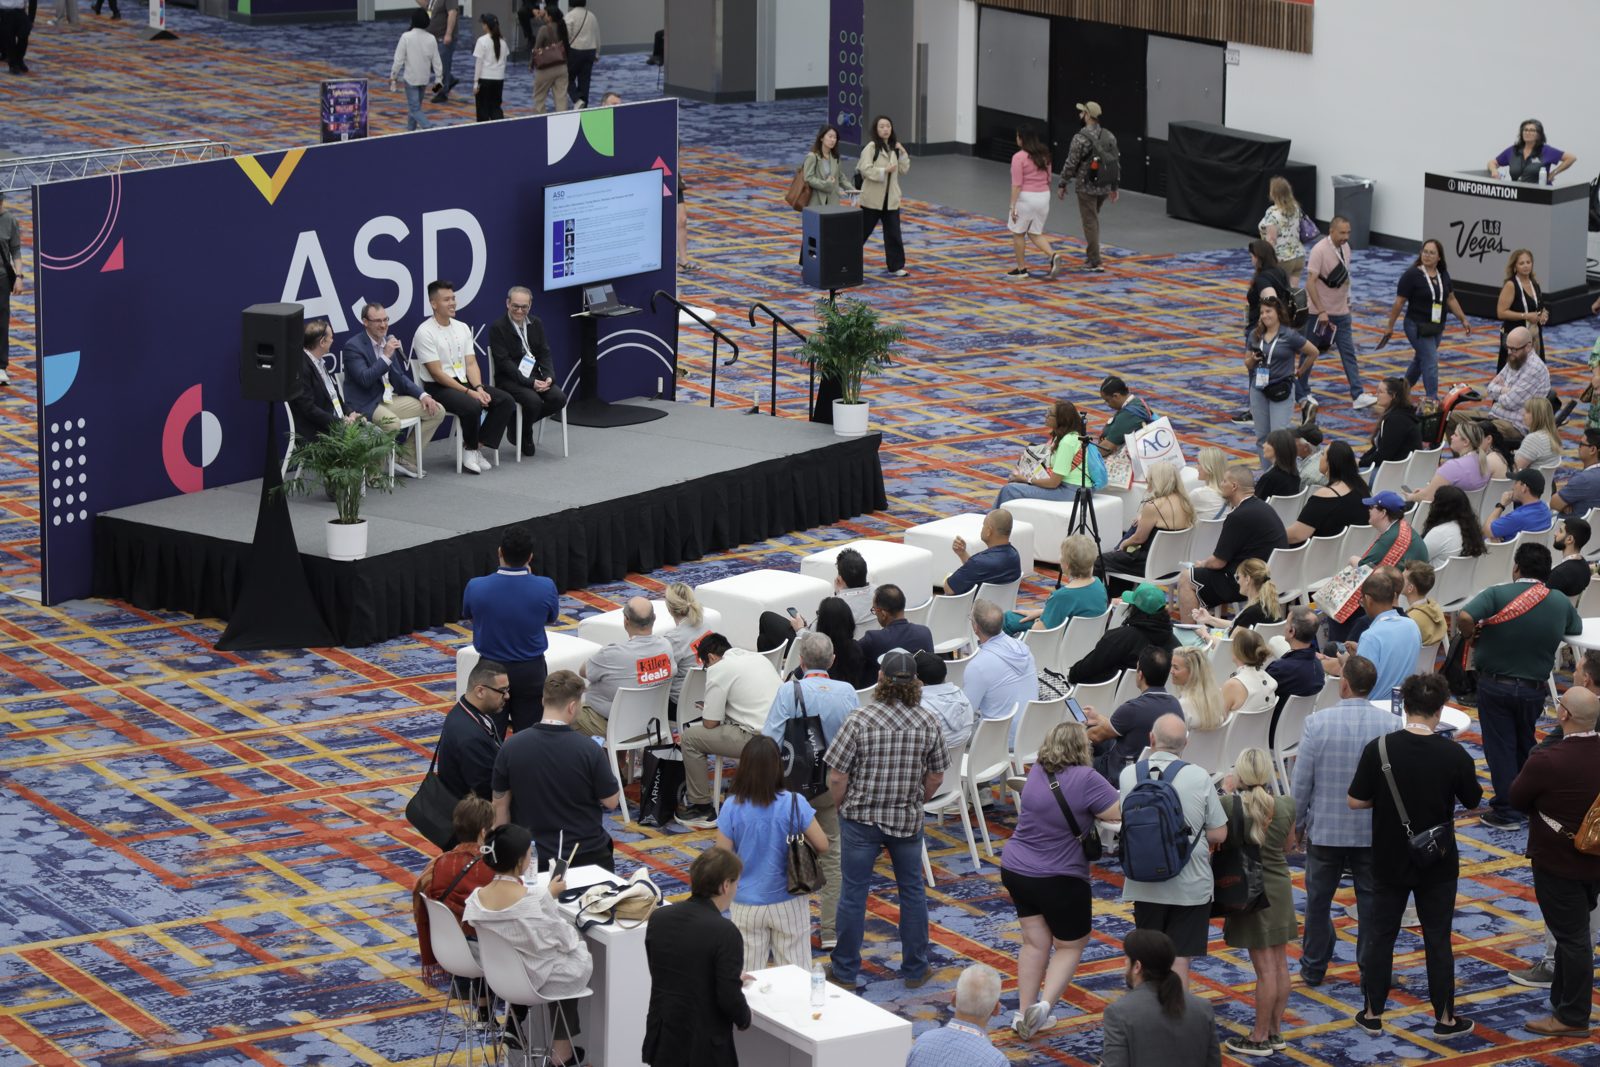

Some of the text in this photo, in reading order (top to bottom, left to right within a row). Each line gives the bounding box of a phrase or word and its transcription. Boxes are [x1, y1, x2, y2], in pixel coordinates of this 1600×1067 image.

[1458, 181, 1518, 199] INFORMATION
[1483, 220, 1501, 235] LAS
[1450, 221, 1510, 263] Vegas
[279, 208, 488, 334] ASD
[639, 657, 667, 673] Killer
[640, 668, 669, 683] deals
